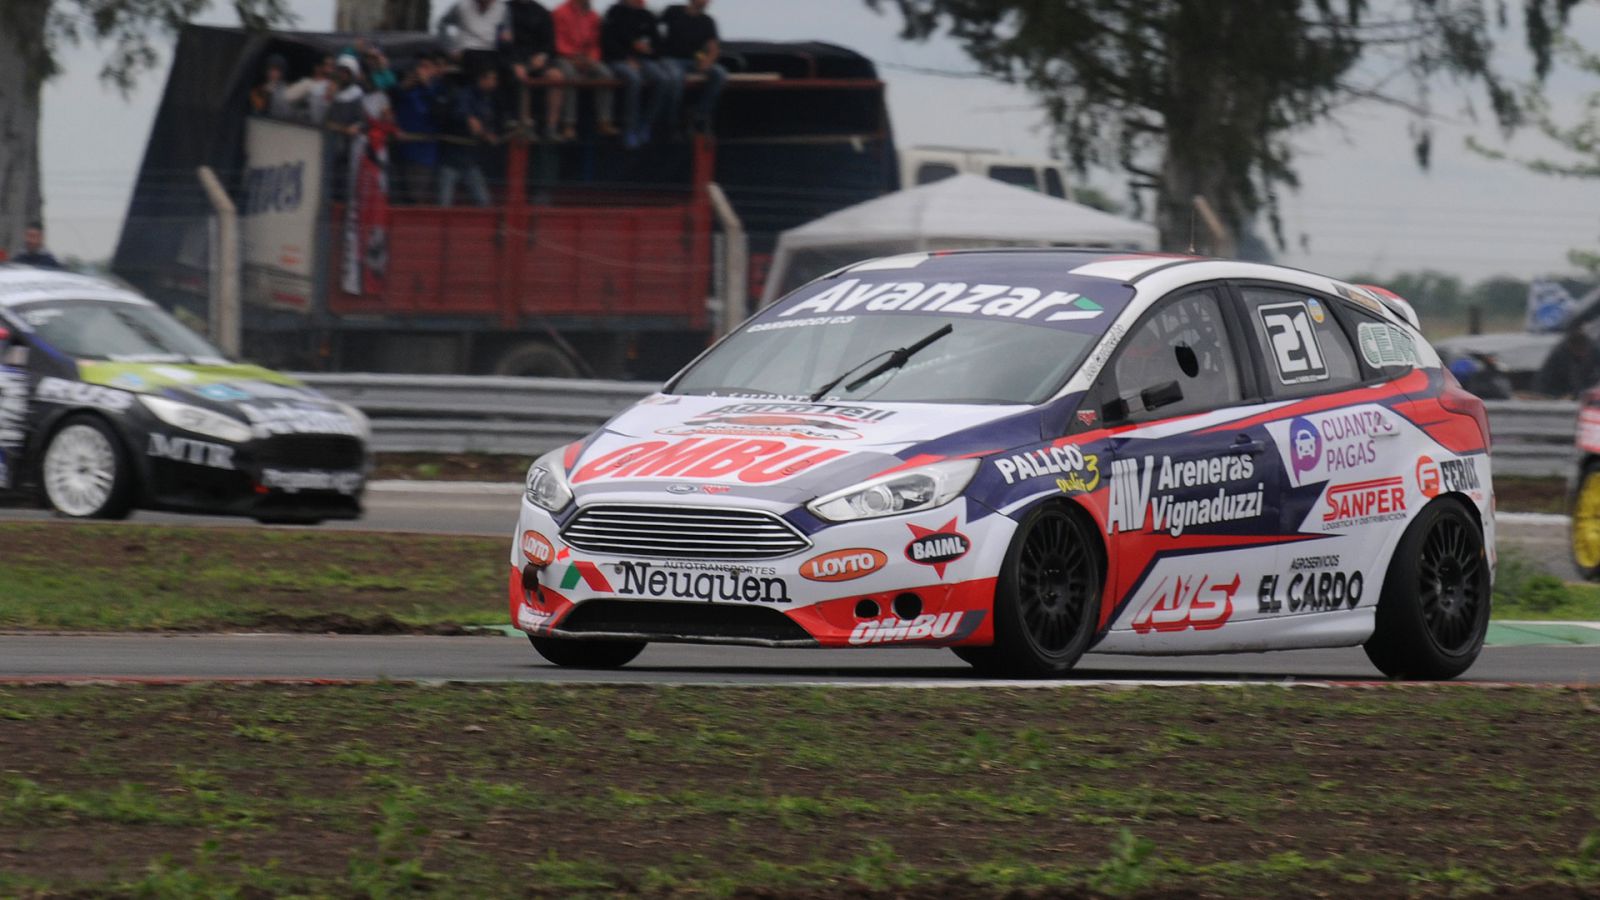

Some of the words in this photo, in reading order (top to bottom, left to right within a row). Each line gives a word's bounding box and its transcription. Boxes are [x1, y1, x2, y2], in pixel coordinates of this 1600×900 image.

[778, 279, 1079, 319] Avanzar
[1265, 311, 1323, 373] 21
[571, 438, 848, 484] OMBU
[994, 443, 1084, 484] PALLCO
[1158, 454, 1254, 490] Areneras
[1326, 440, 1376, 472] PAGAS
[1151, 483, 1264, 537] Vignaduzzi
[1323, 477, 1406, 522] SANPER
[812, 553, 875, 577] LOYTO
[913, 537, 967, 560] BAIML
[618, 561, 792, 603] Neuquen
[1258, 574, 1282, 613] EL
[1286, 570, 1364, 613] CARDO
[848, 610, 963, 645] OMBU
